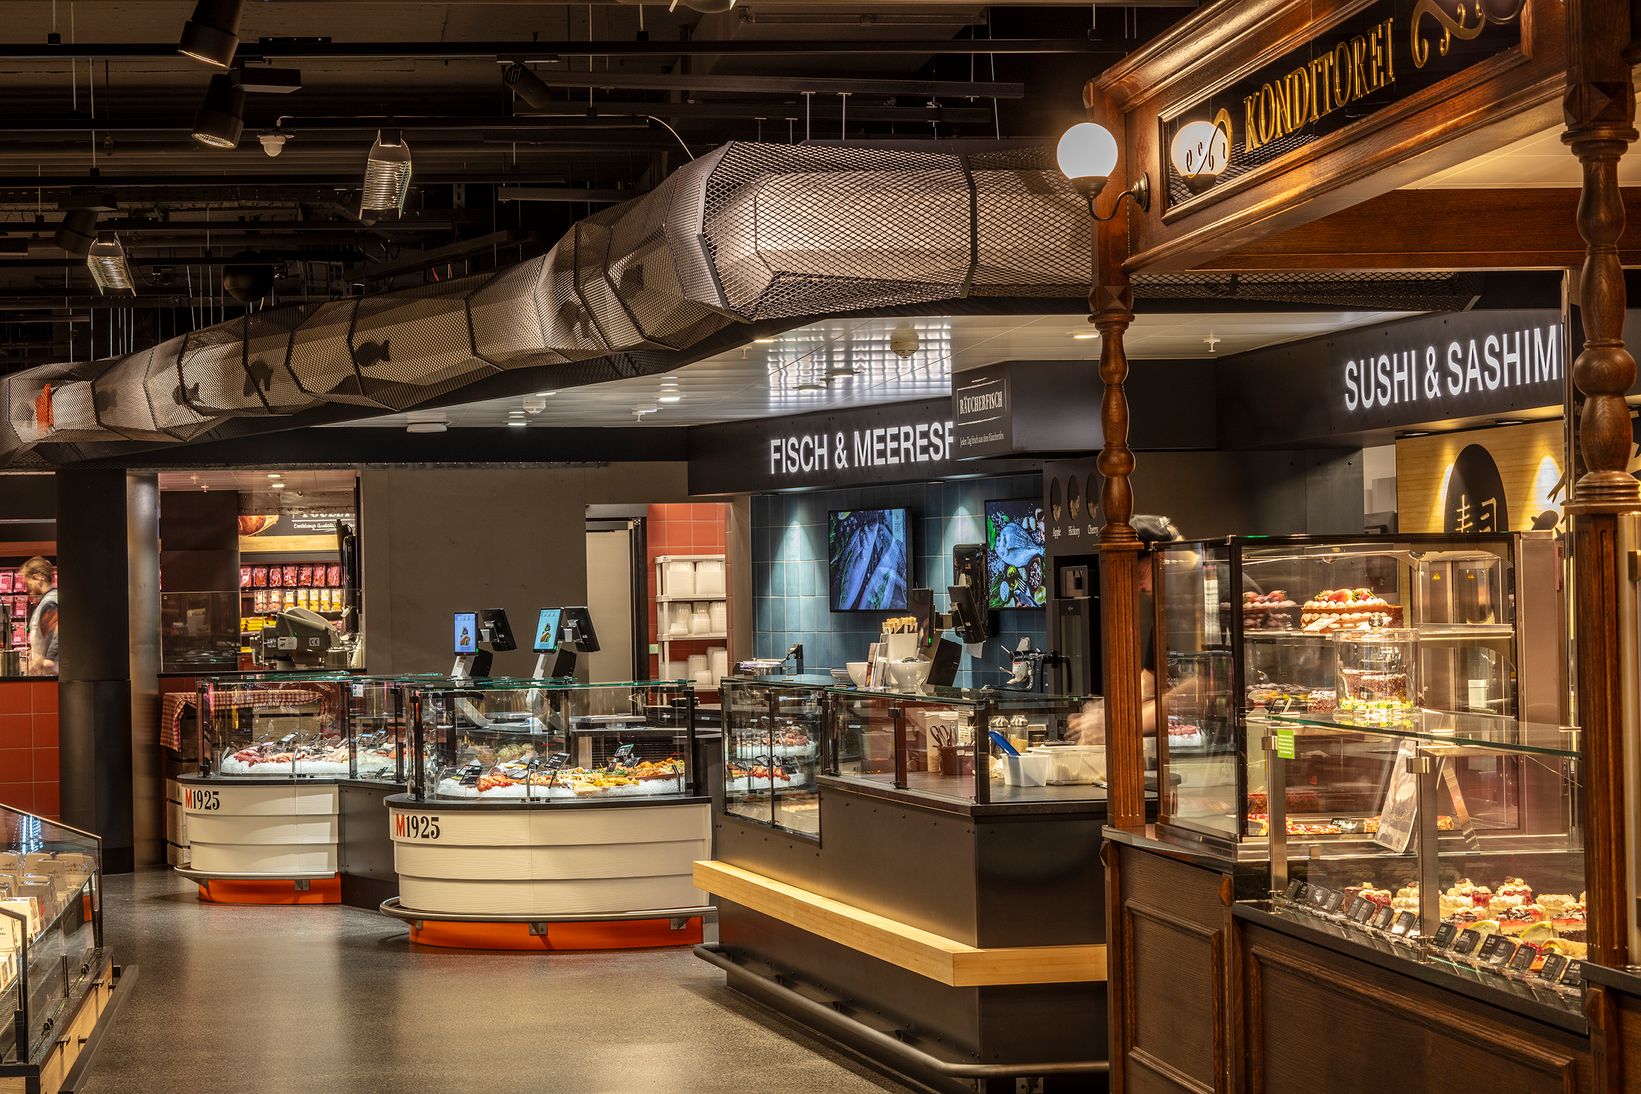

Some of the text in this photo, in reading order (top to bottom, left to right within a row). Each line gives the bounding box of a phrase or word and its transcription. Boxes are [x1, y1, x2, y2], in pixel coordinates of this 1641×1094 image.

[1243, 16, 1396, 154] KONDITOREI
[1345, 350, 1416, 411] SUSHI
[1424, 345, 1441, 399] &
[959, 391, 1003, 415] RÄUCHERFISCH
[770, 434, 828, 474] FISCH
[834, 432, 848, 469] &
[1088, 524, 1099, 536] Cherry
[185, 788, 220, 811] M1925
[395, 813, 441, 840] M1925
